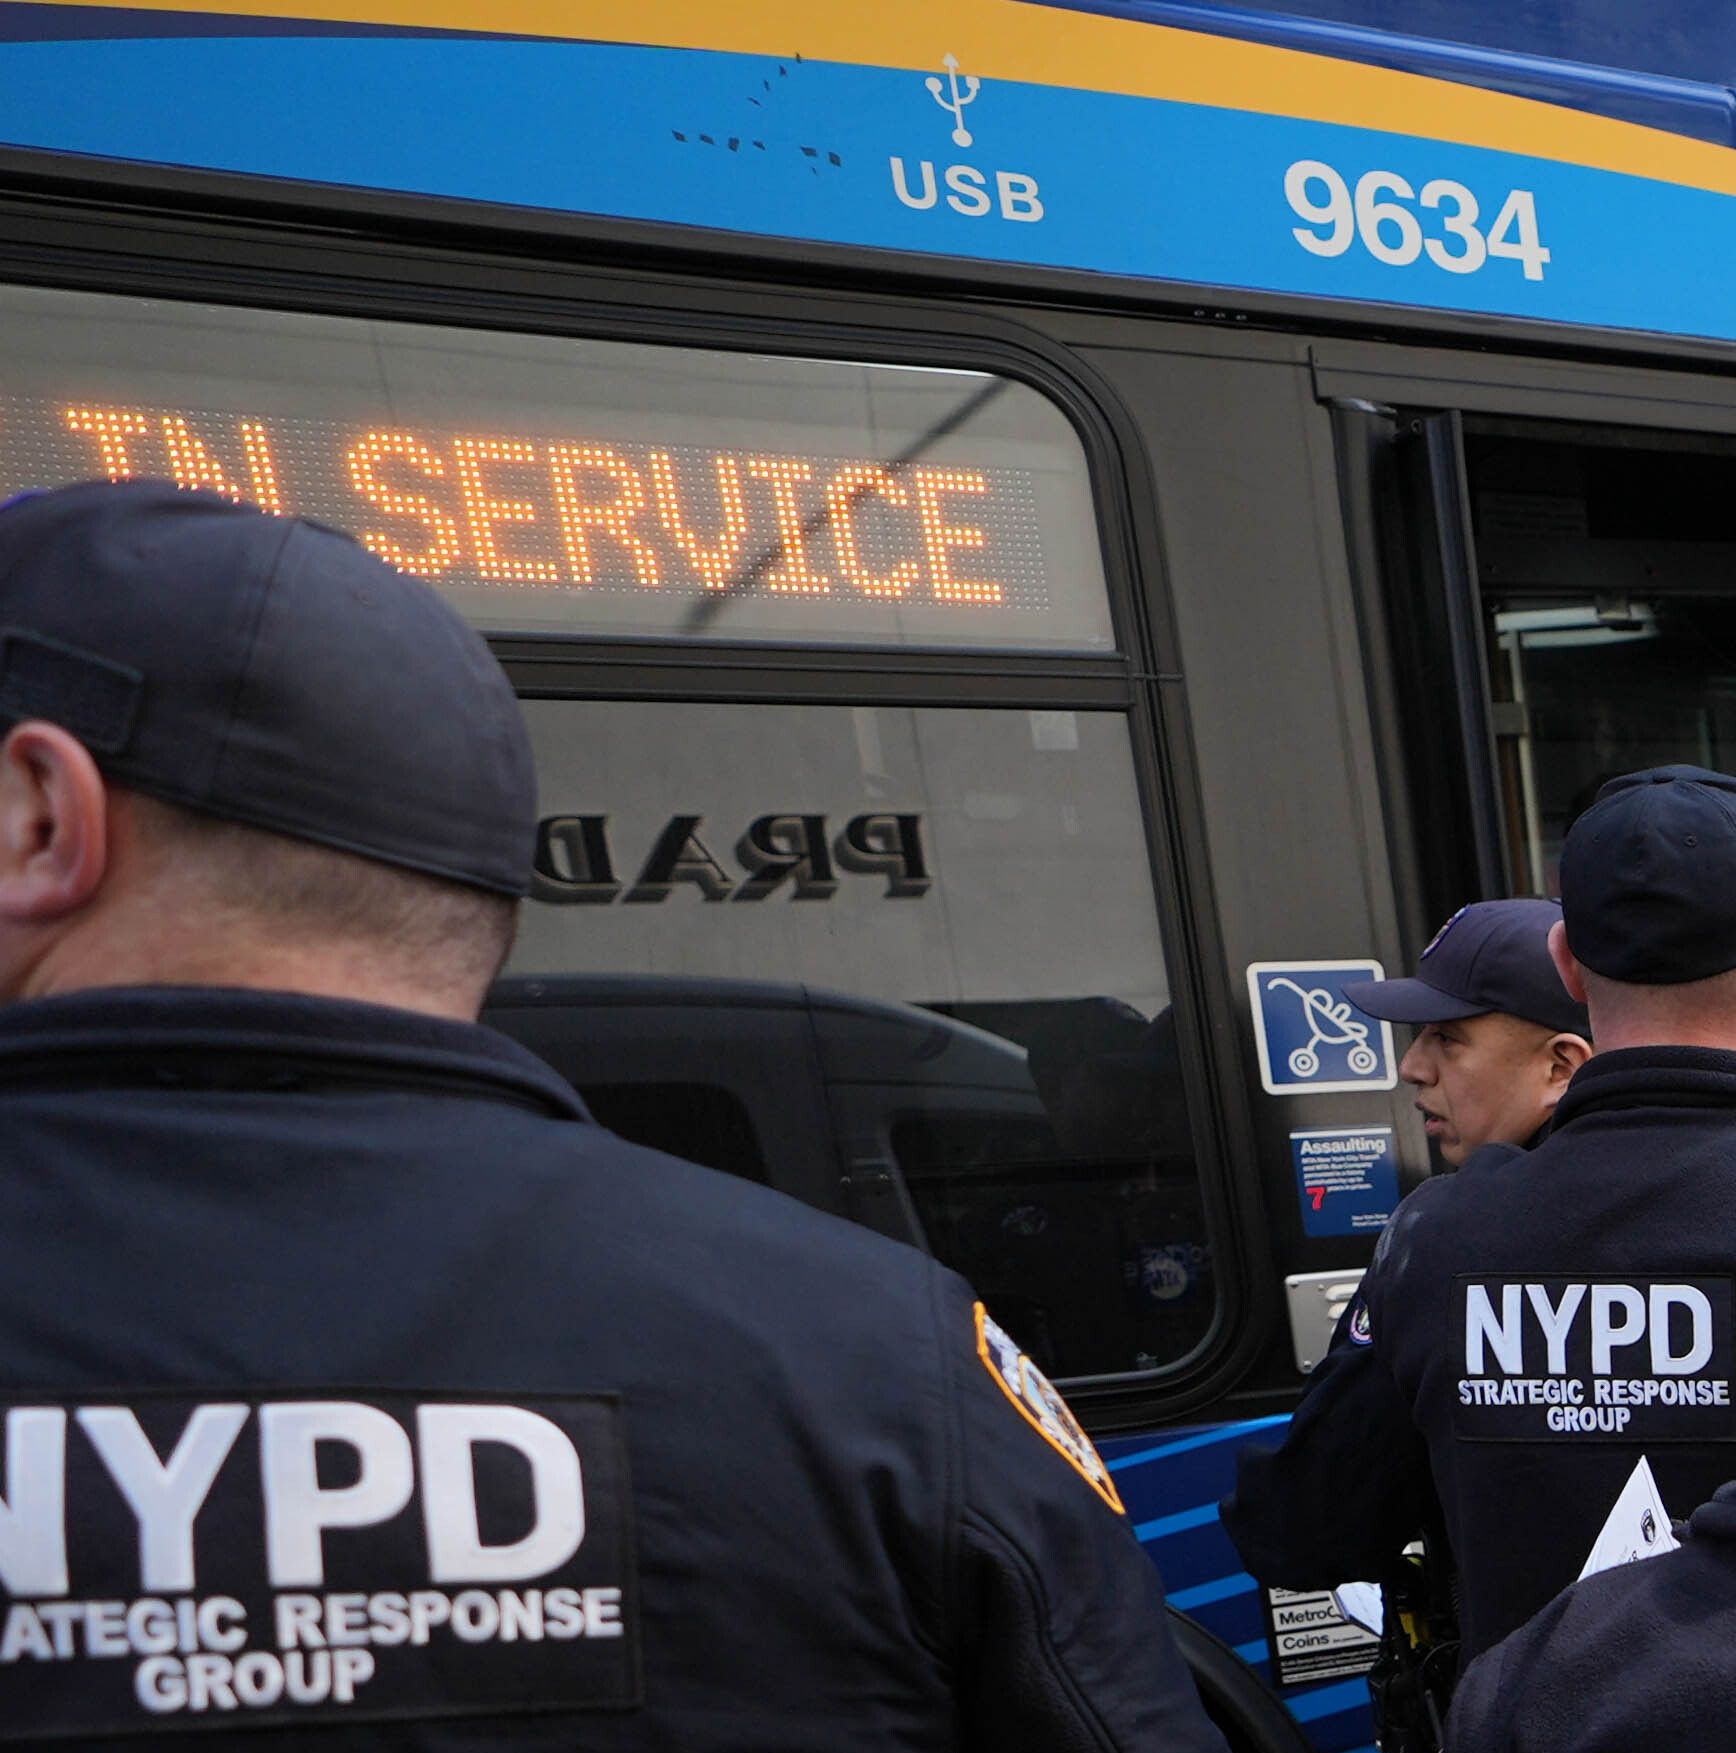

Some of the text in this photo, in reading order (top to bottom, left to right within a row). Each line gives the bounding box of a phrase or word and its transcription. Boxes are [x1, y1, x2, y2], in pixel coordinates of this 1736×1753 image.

[888, 156, 1045, 223] USB
[1283, 159, 1551, 282] 9634
[348, 432, 1001, 603] SERVICE
[1300, 1137, 1387, 1155] Assaulting
[1306, 1186, 1326, 1211] 7
[1465, 1284, 1714, 1376] NYPD
[1458, 1379, 1731, 1407] STRATEGIC RESPONSE
[1546, 1406, 1631, 1433] GROUP
[275, 1587, 624, 1651] RESPONSE
[1282, 1633, 1330, 1650] Coins
[135, 1647, 375, 1714] GROUP
